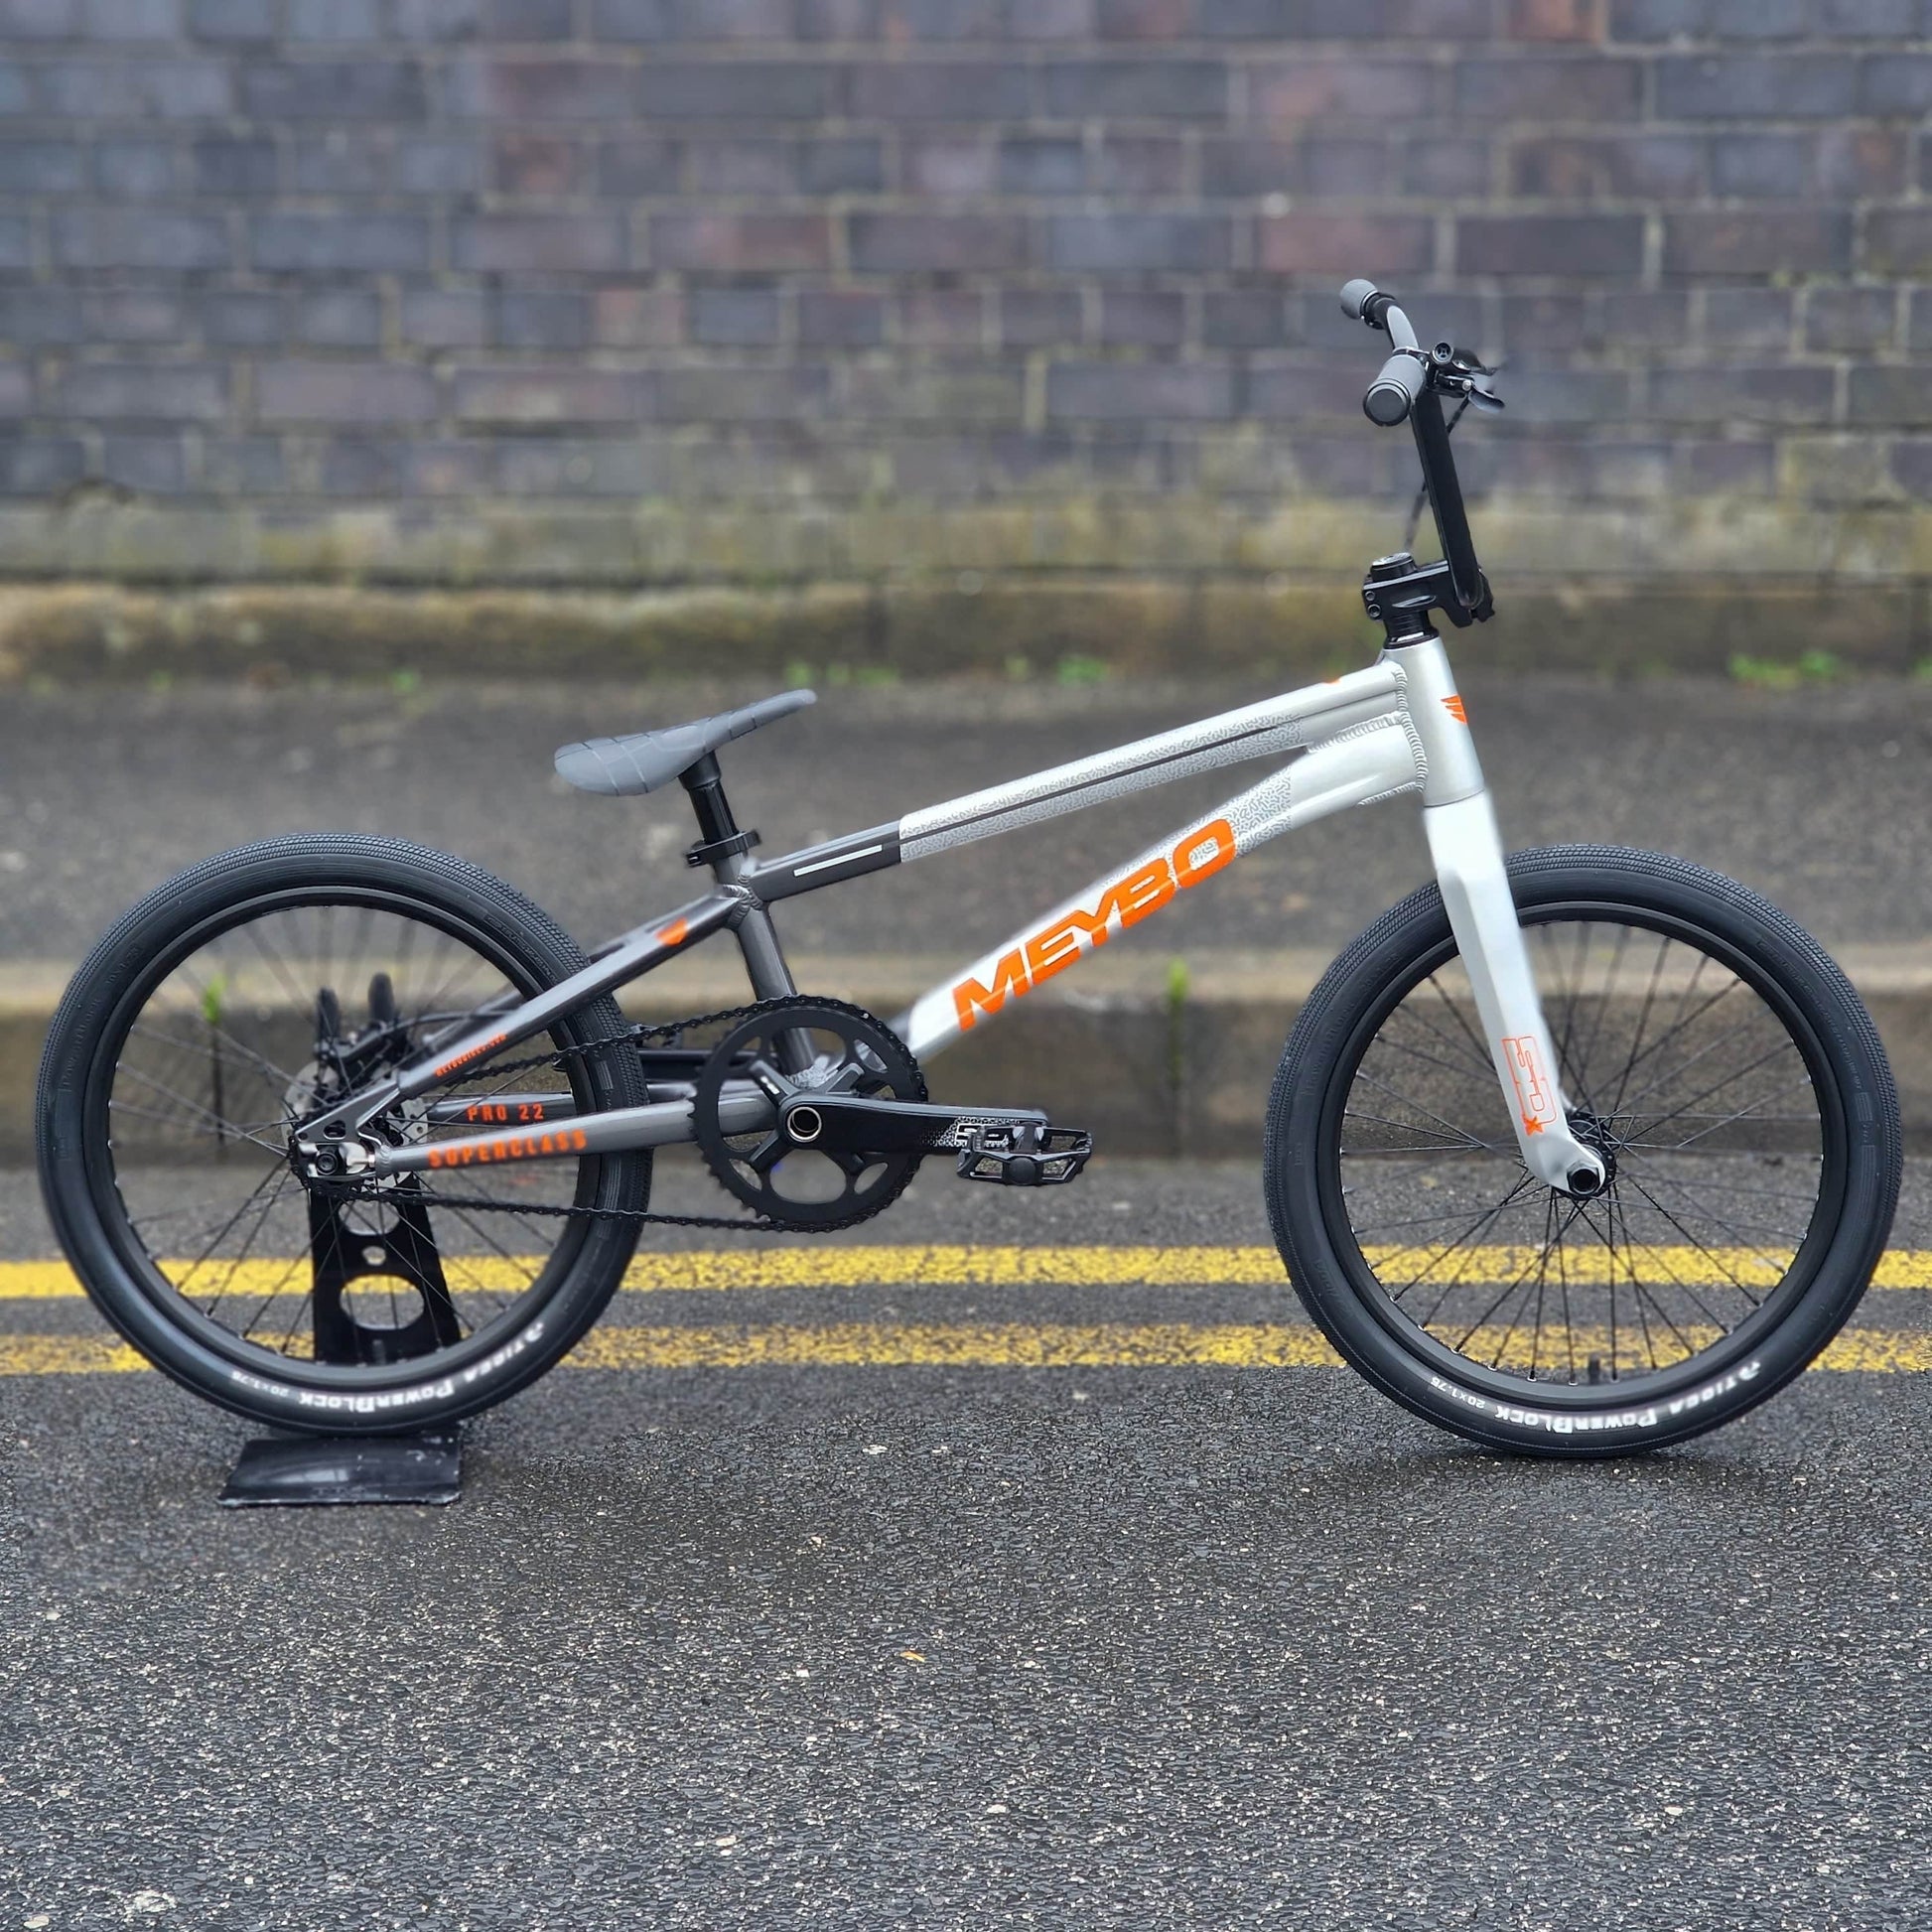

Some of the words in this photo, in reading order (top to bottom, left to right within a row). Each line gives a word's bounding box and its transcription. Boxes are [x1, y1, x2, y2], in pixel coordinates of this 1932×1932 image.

[952, 819, 1237, 1032] MEYBO
[467, 1103, 508, 1122] PRO
[518, 1103, 545, 1121] 22
[428, 1129, 588, 1169] SUPERCLASS
[1430, 1375, 1485, 1410] 20x1.75
[1669, 1379, 1736, 1415] TIOGA
